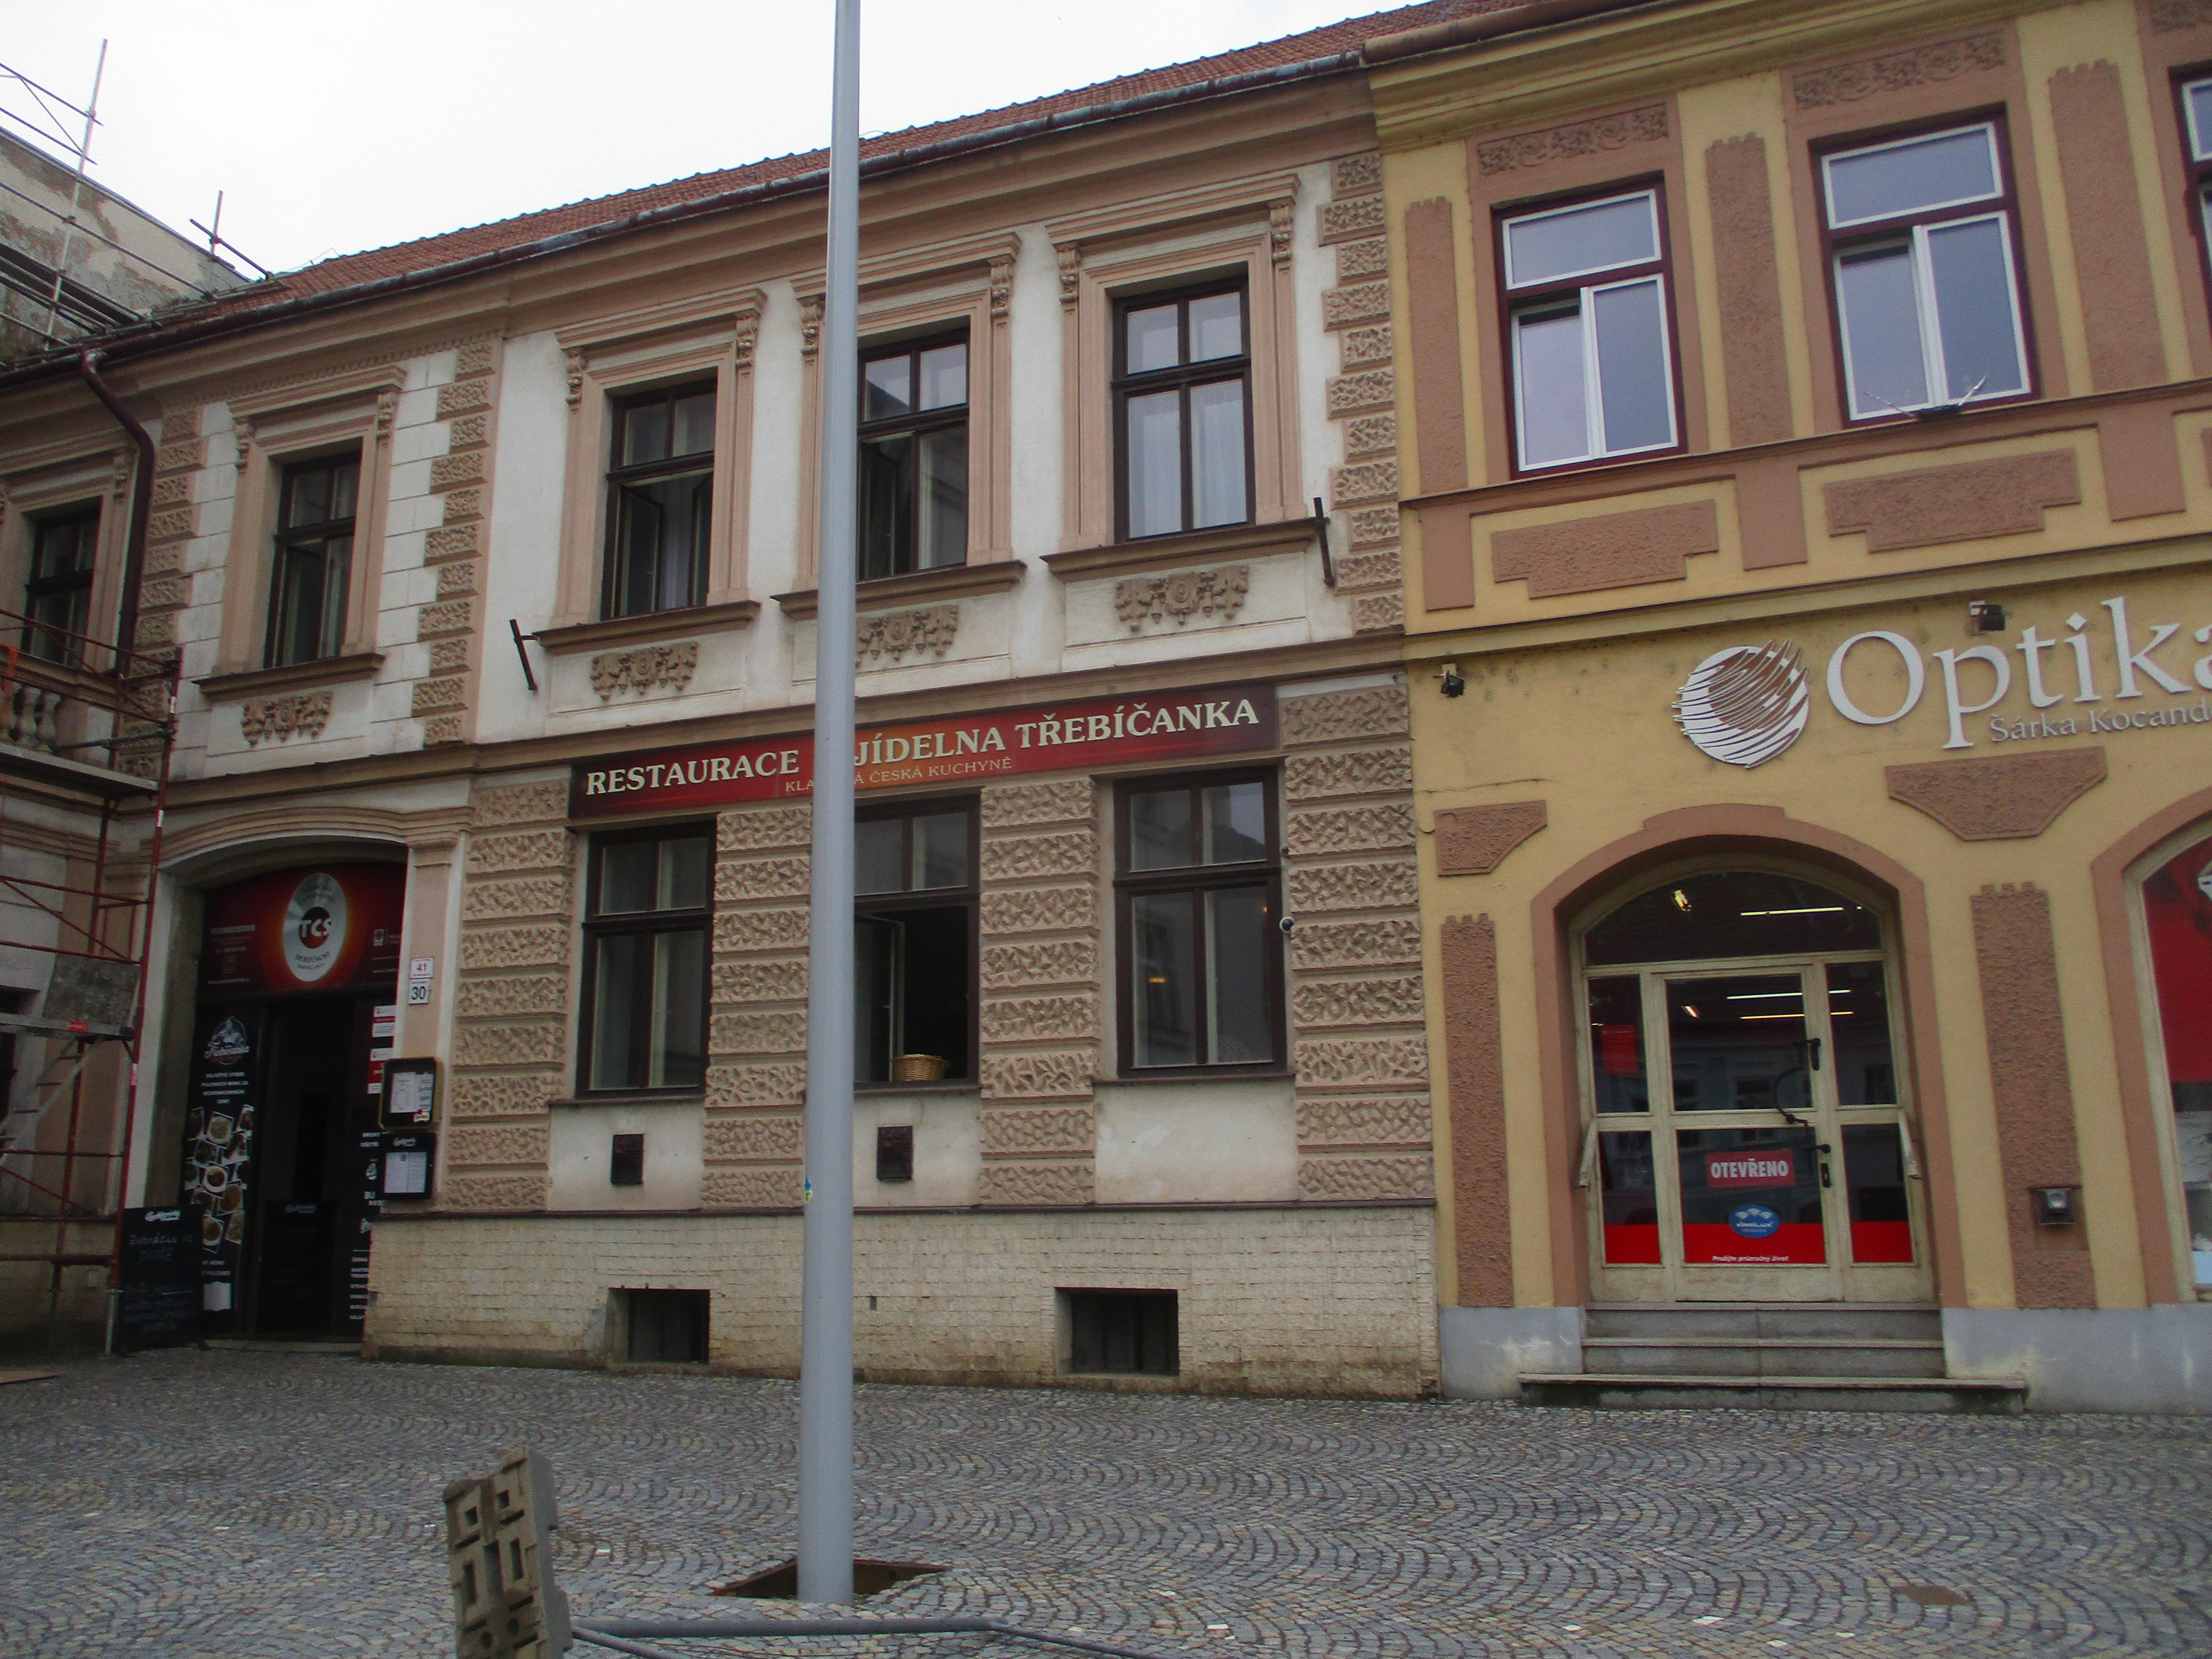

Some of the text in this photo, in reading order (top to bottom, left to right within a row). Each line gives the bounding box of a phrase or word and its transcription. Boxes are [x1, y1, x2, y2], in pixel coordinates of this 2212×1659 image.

[1827, 597, 2212, 748] Optik
[1991, 696, 2212, 742] Šárka Kocand
[586, 698, 1259, 795] RESTAURACE JÍDELNA TŘEBÍČANKA
[869, 766, 922, 783] ČESKÁ
[928, 757, 1012, 777] KUCHYNĚ
[299, 918, 332, 938] TCS
[416, 963, 427, 972] 41
[411, 986, 426, 1000] 30
[1711, 1158, 1789, 1178] OTEVŘENO
